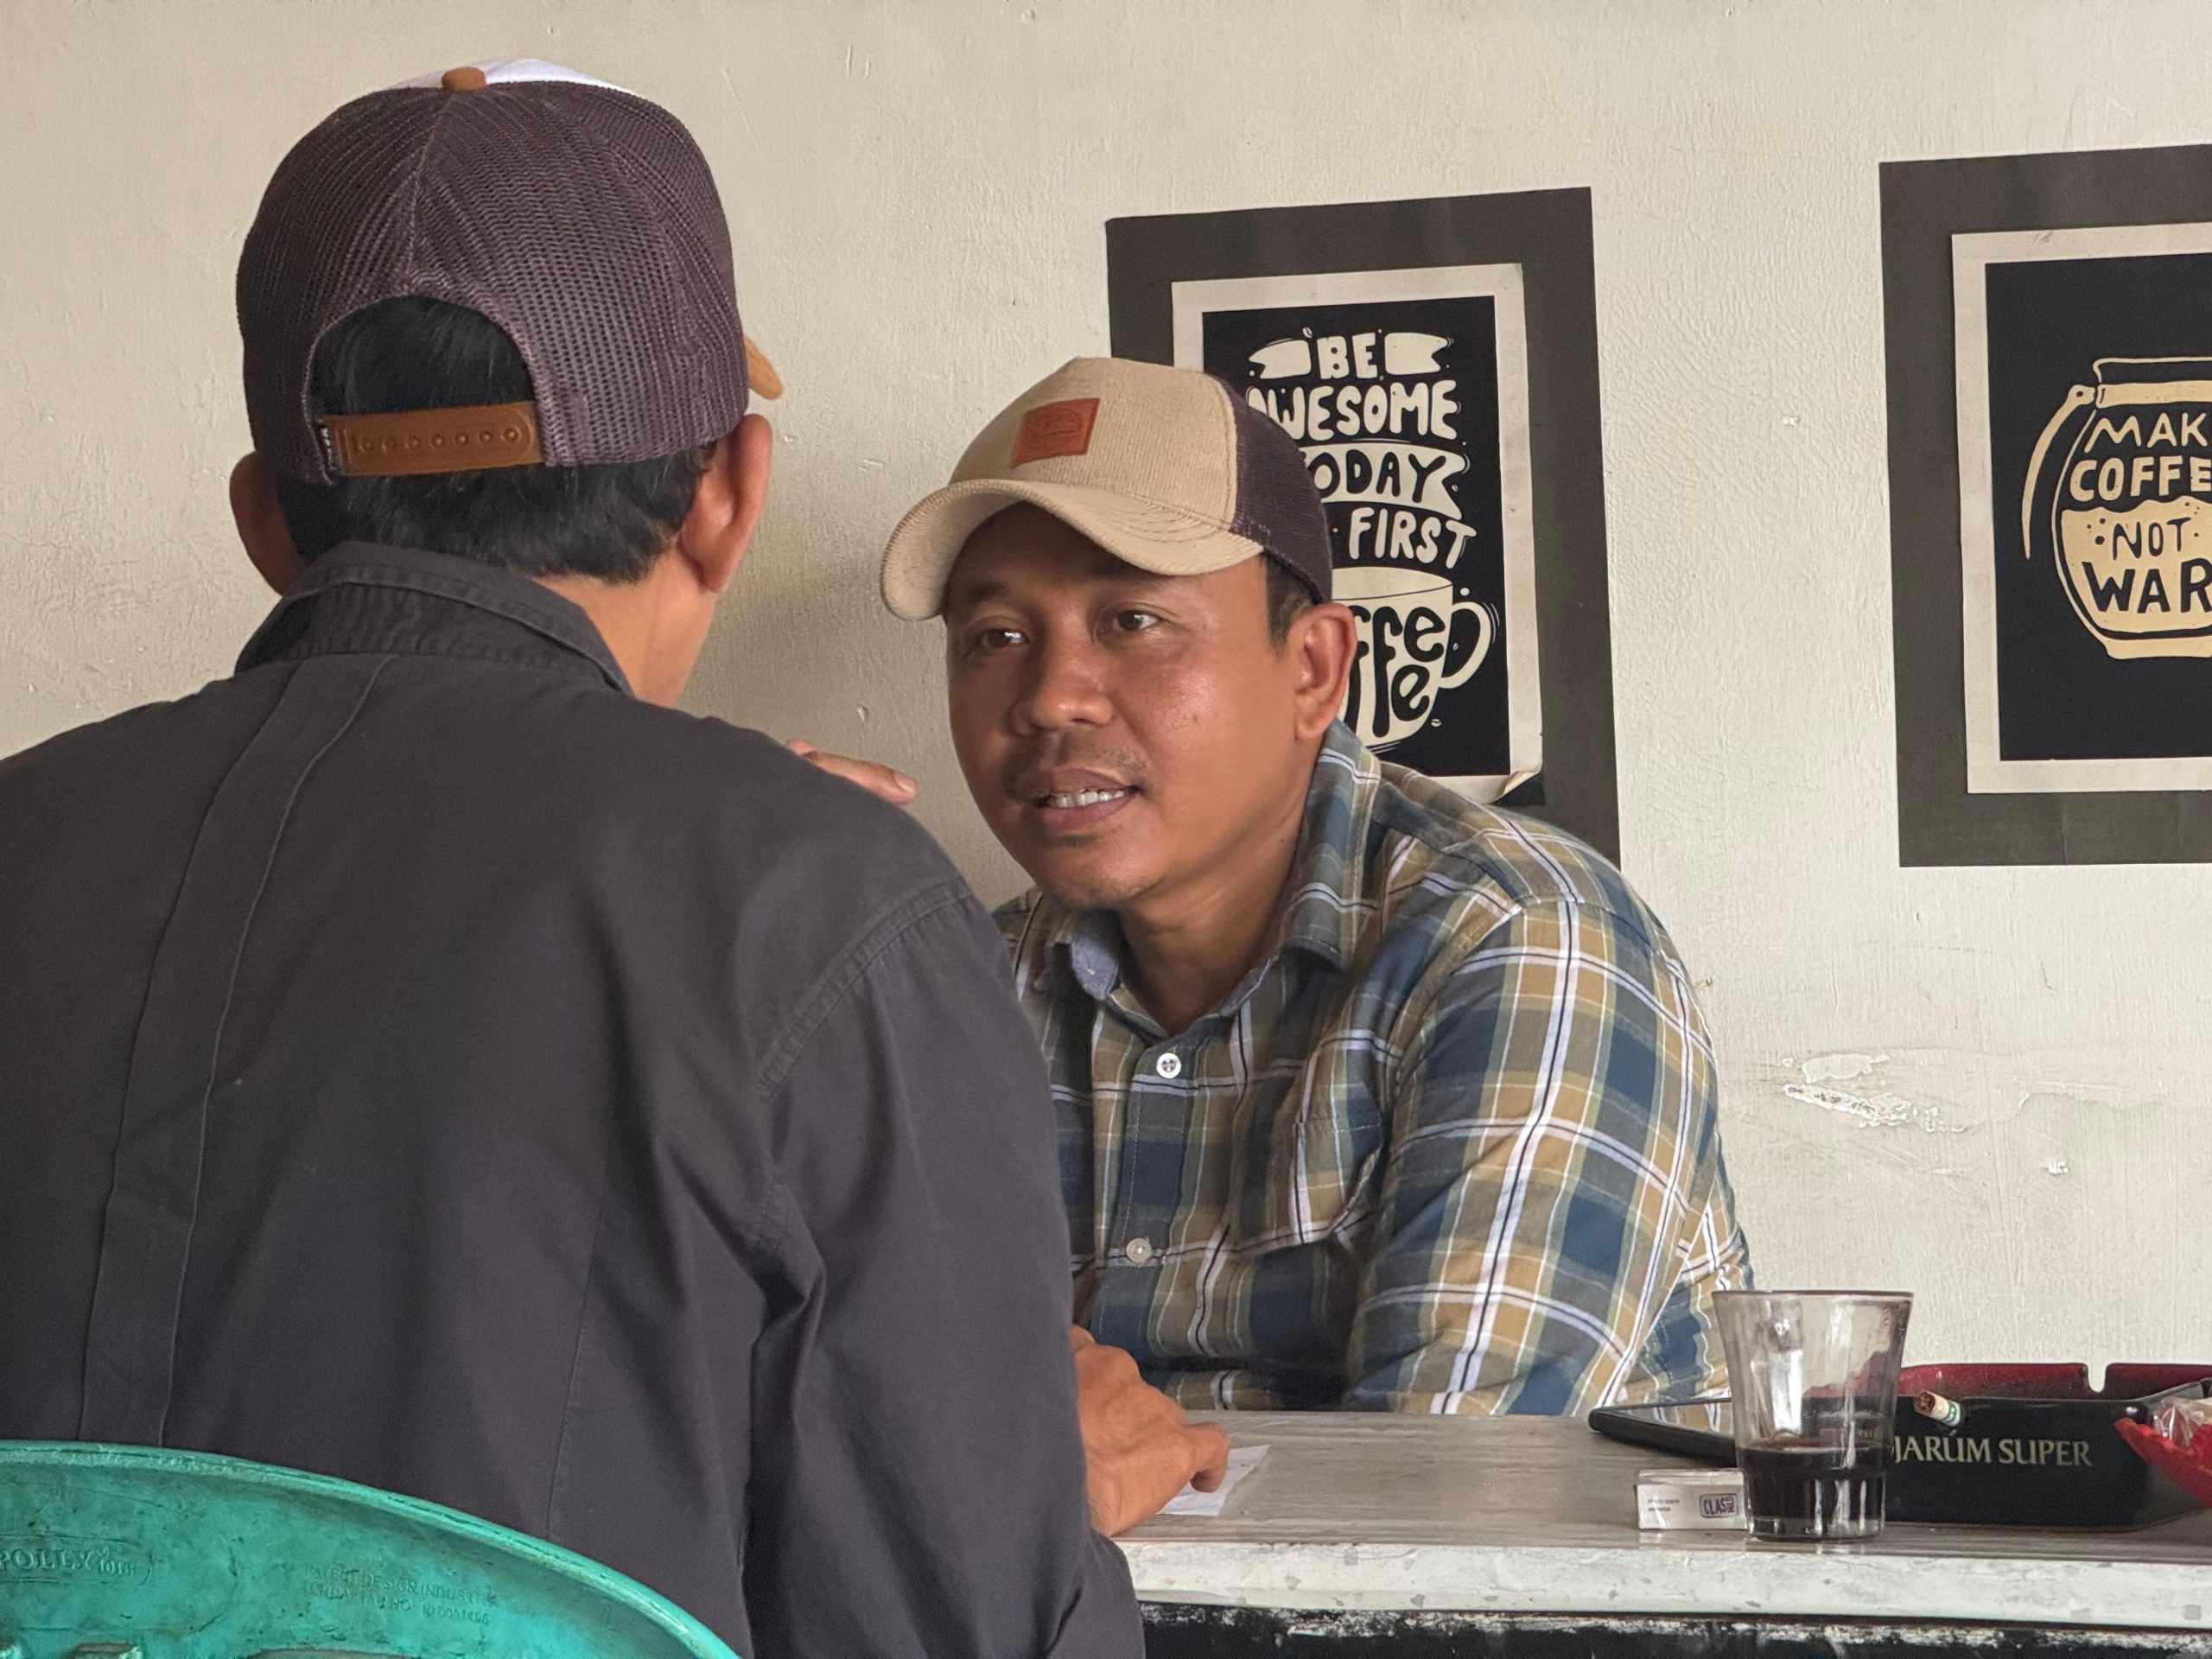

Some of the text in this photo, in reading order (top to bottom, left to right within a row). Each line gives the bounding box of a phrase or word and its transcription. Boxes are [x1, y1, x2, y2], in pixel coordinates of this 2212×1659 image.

[1317, 333, 1378, 380] BE
[2083, 412, 2212, 454] MAK
[1300, 449, 1447, 503] ODAY
[2069, 455, 2212, 502] COFFE
[1349, 506, 1478, 569] FIRST
[2113, 517, 2192, 561] NOT
[2081, 557, 2212, 613] WAR
[1891, 1434, 2093, 1467] JARUM SUPER
[1703, 1497, 1726, 1515] CLAS
